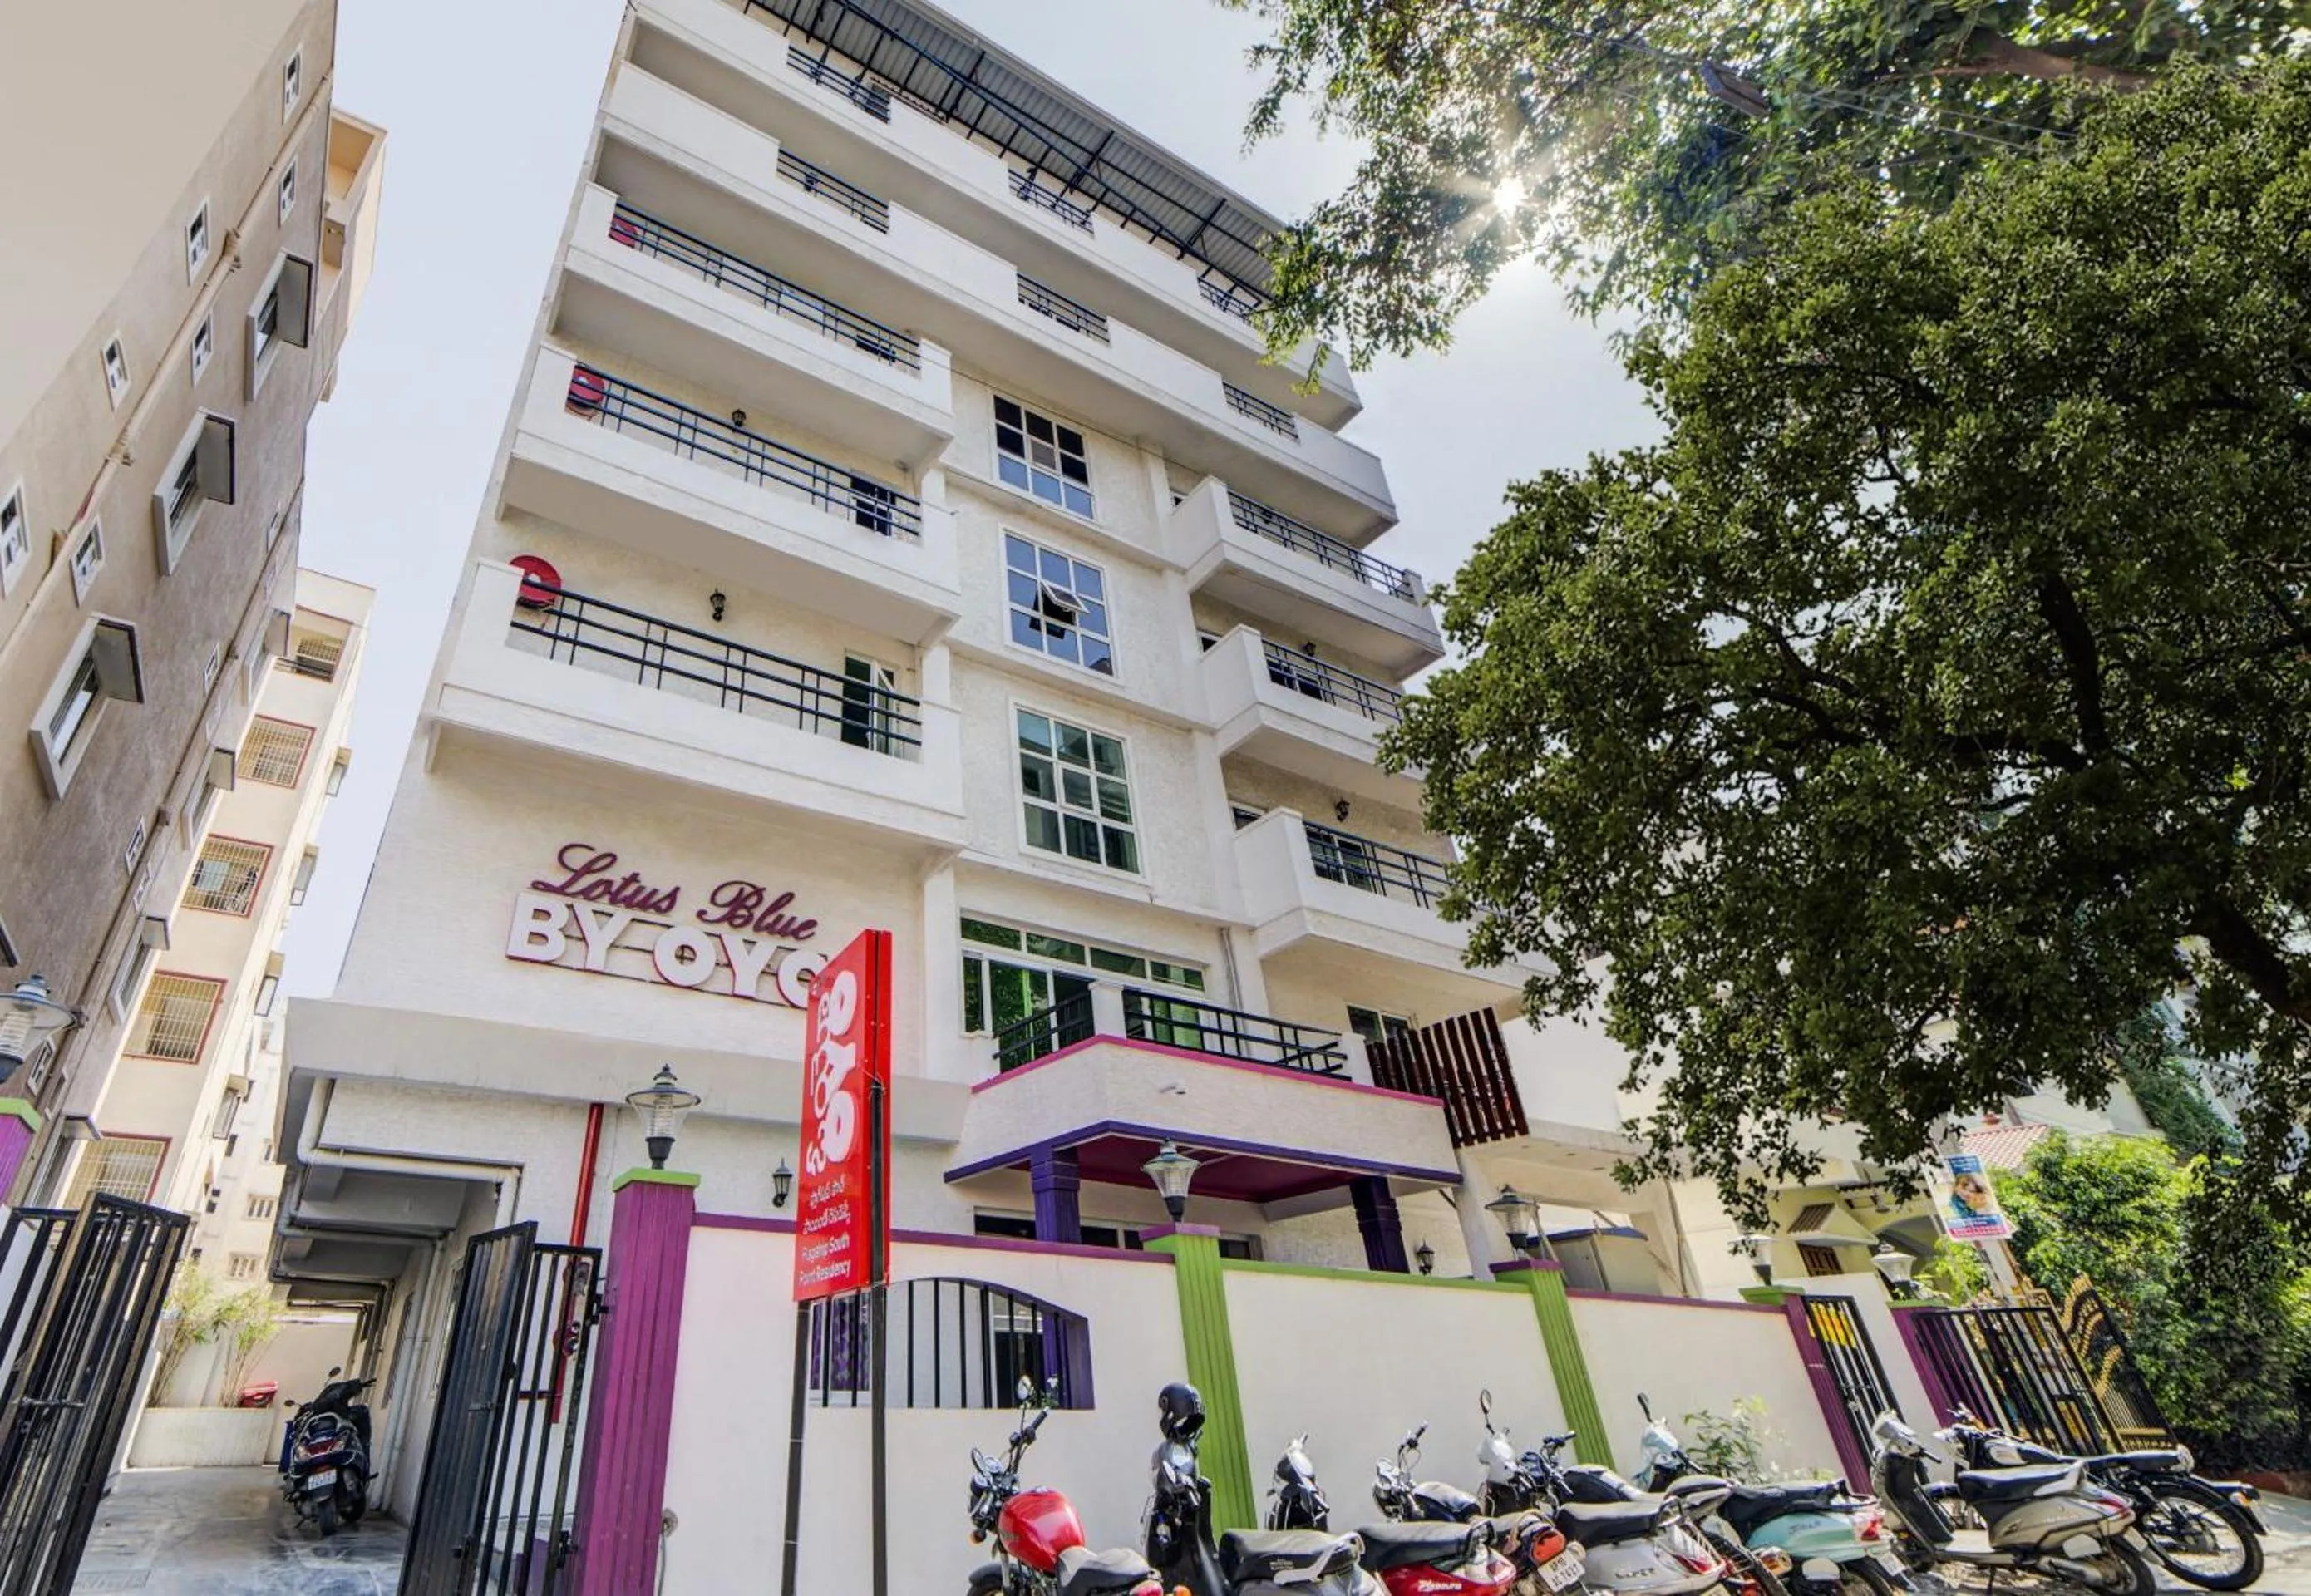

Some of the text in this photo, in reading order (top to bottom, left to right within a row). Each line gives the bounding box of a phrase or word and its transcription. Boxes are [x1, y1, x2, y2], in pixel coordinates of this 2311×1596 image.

[505, 891, 633, 973] BY
[530, 843, 819, 940] Lotus Blue
[819, 968, 858, 1164] OYO
